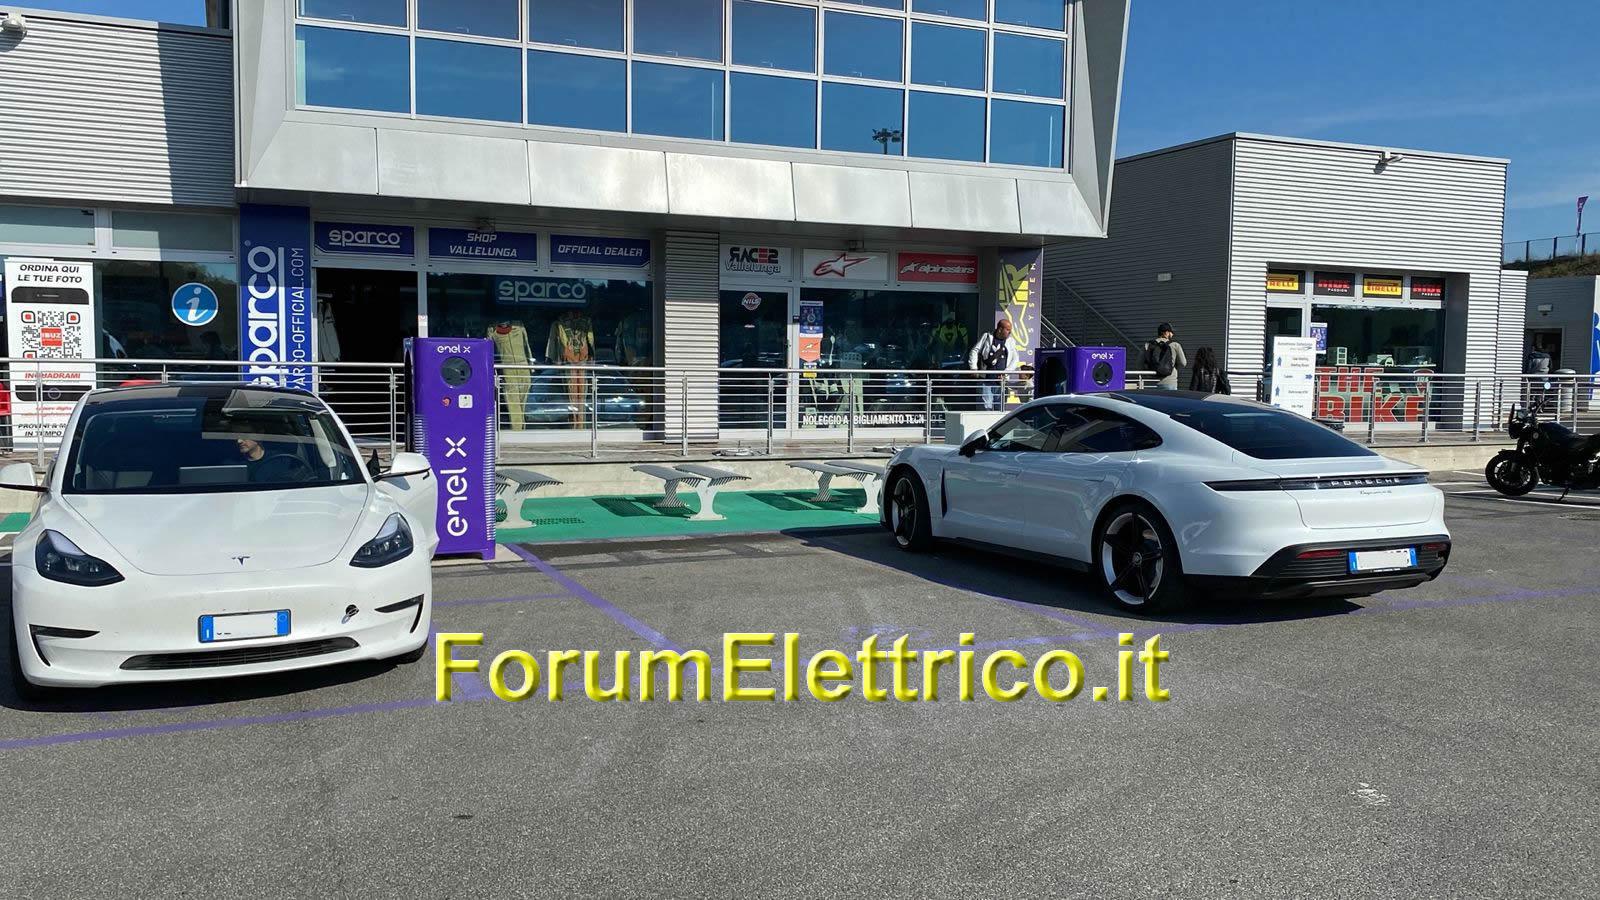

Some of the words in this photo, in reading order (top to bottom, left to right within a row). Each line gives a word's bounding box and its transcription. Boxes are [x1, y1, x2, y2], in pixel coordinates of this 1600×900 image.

[329, 230, 400, 247] sparco
[467, 233, 497, 243] SHOP
[450, 245, 517, 257] VALLELUNGA
[558, 244, 602, 255] OFFICIAL
[604, 246, 643, 257] DEALER
[19, 264, 59, 272] ORDINA
[61, 265, 79, 273] QUI
[725, 260, 781, 275] Vallelunga
[17, 274, 31, 282] LE
[33, 274, 54, 283] TUE
[55, 275, 83, 283] FOTO
[498, 280, 586, 302] sparco
[437, 344, 461, 353] enel
[1091, 352, 1108, 360] enel
[1315, 367, 1384, 393] THE
[1318, 395, 1426, 422] BIKE
[802, 414, 841, 425] NOLEGGIO
[1331, 477, 1400, 486] PORSCHE
[440, 466, 468, 537] enel
